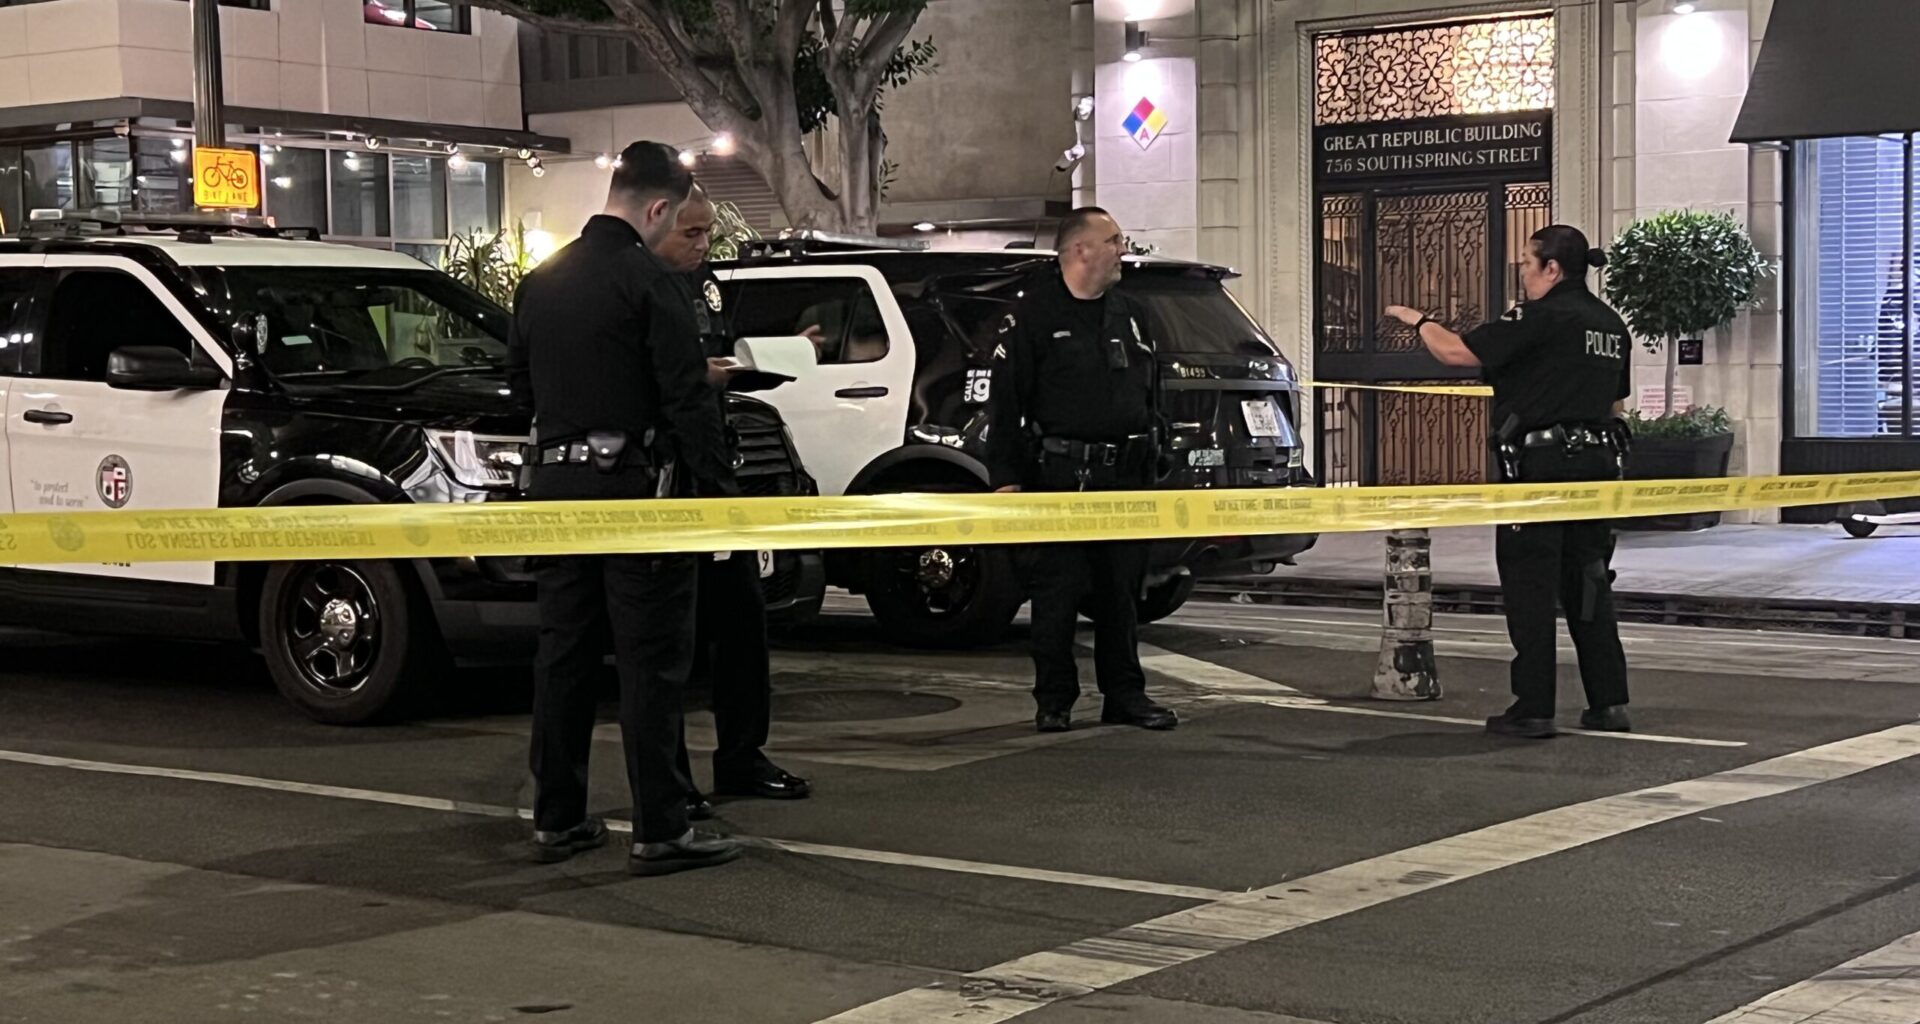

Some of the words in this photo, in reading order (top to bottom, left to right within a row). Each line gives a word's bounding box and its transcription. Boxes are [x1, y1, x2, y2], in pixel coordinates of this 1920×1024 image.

[1139, 127, 1151, 141] A
[1323, 133, 1379, 151] GREAT
[1381, 128, 1462, 148] REPUBLIC
[1464, 121, 1542, 143] BUILDING
[1325, 158, 1352, 173] 756
[1356, 153, 1413, 172] SOUTH
[1414, 150, 1473, 168] SPRING
[1475, 146, 1542, 165] STREET
[1585, 329, 1621, 359] POLICE
[964, 378, 974, 402] CALL
